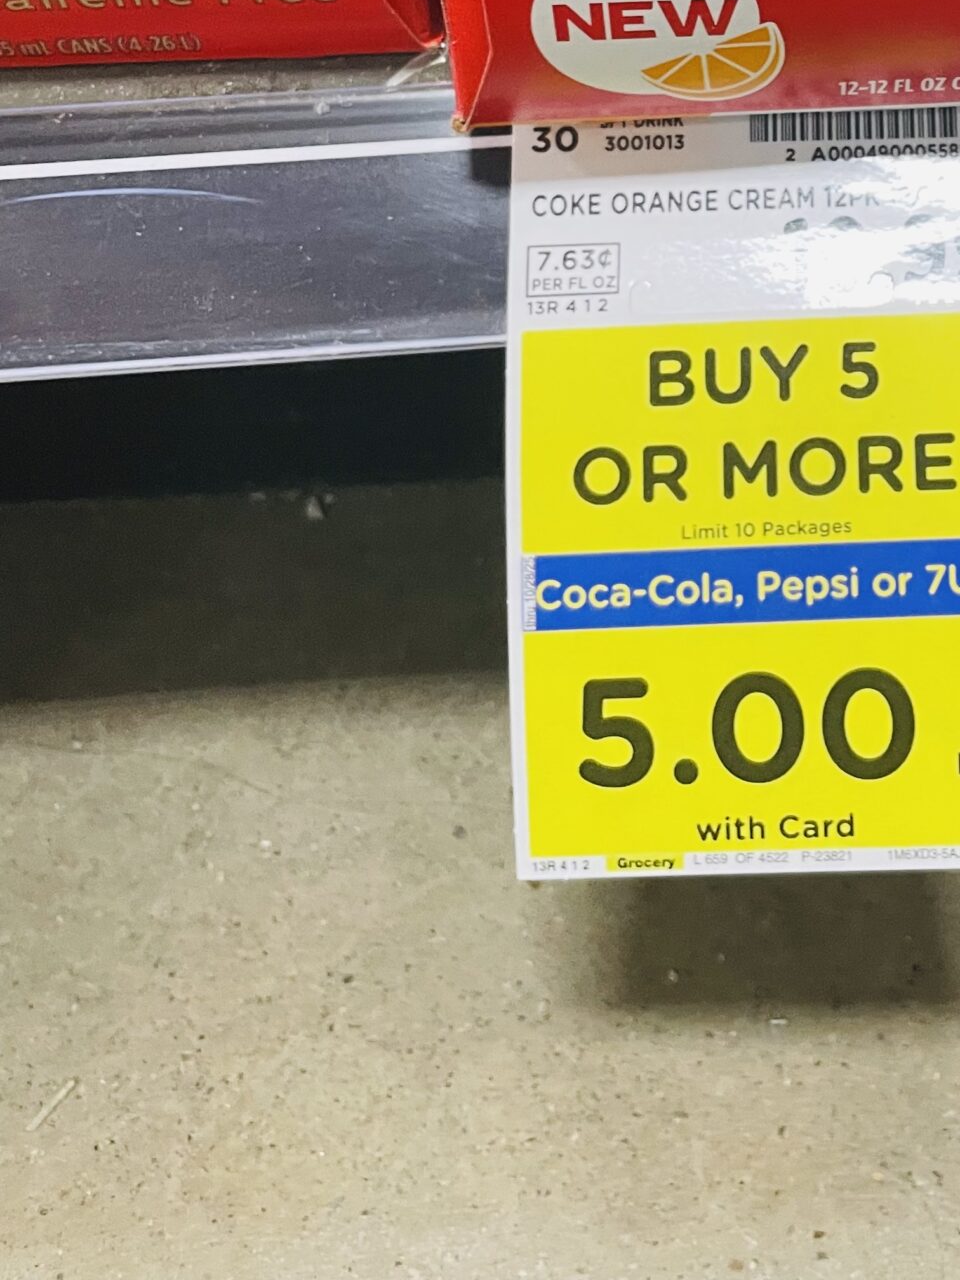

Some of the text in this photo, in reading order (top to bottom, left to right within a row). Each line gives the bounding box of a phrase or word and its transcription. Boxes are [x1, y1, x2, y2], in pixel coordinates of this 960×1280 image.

[56, 37, 112, 54] CANS
[837, 81, 889, 97] 12-12
[893, 79, 915, 94] FL
[921, 77, 946, 93] OZ
[531, 125, 579, 153] 30
[605, 134, 685, 152] 3001013
[785, 148, 796, 161] 2
[531, 194, 601, 217] COKE
[611, 189, 719, 215] ORANGE
[728, 187, 815, 211] CREAM
[532, 275, 616, 292] PER FL OZ
[527, 298, 608, 315] 13R 4 1 2
[648, 341, 879, 407] BUY 5
[573, 432, 957, 506] OR MORE
[681, 519, 852, 541] Limit 10 Packages
[535, 571, 744, 613] Coca-Cola,
[757, 566, 860, 606] Pepsi
[872, 571, 912, 597] or
[579, 667, 916, 788] 5.00
[696, 813, 855, 841] with Card
[617, 857, 676, 870] Grocery
[735, 852, 753, 864] OF
